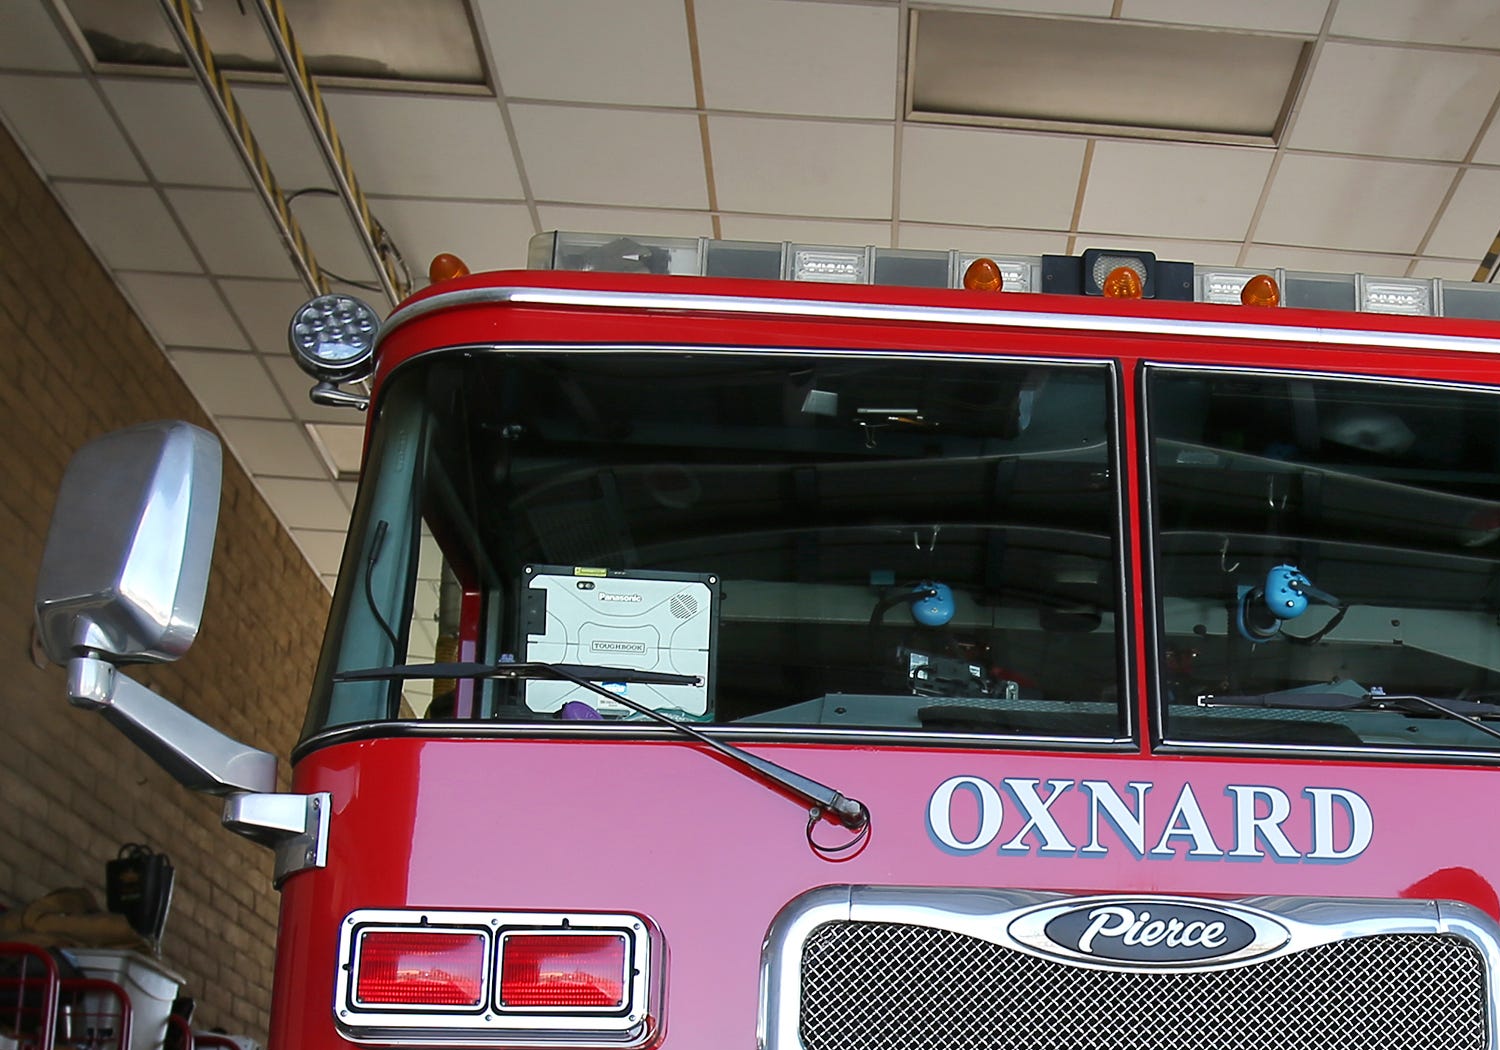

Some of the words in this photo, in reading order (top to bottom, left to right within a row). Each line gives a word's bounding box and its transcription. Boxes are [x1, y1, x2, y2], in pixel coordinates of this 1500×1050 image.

[598, 592, 642, 602] Panasonic
[594, 643, 643, 651] TOUGHBOOK
[926, 775, 1374, 863] OXNARD
[1078, 904, 1228, 954] Pierce
